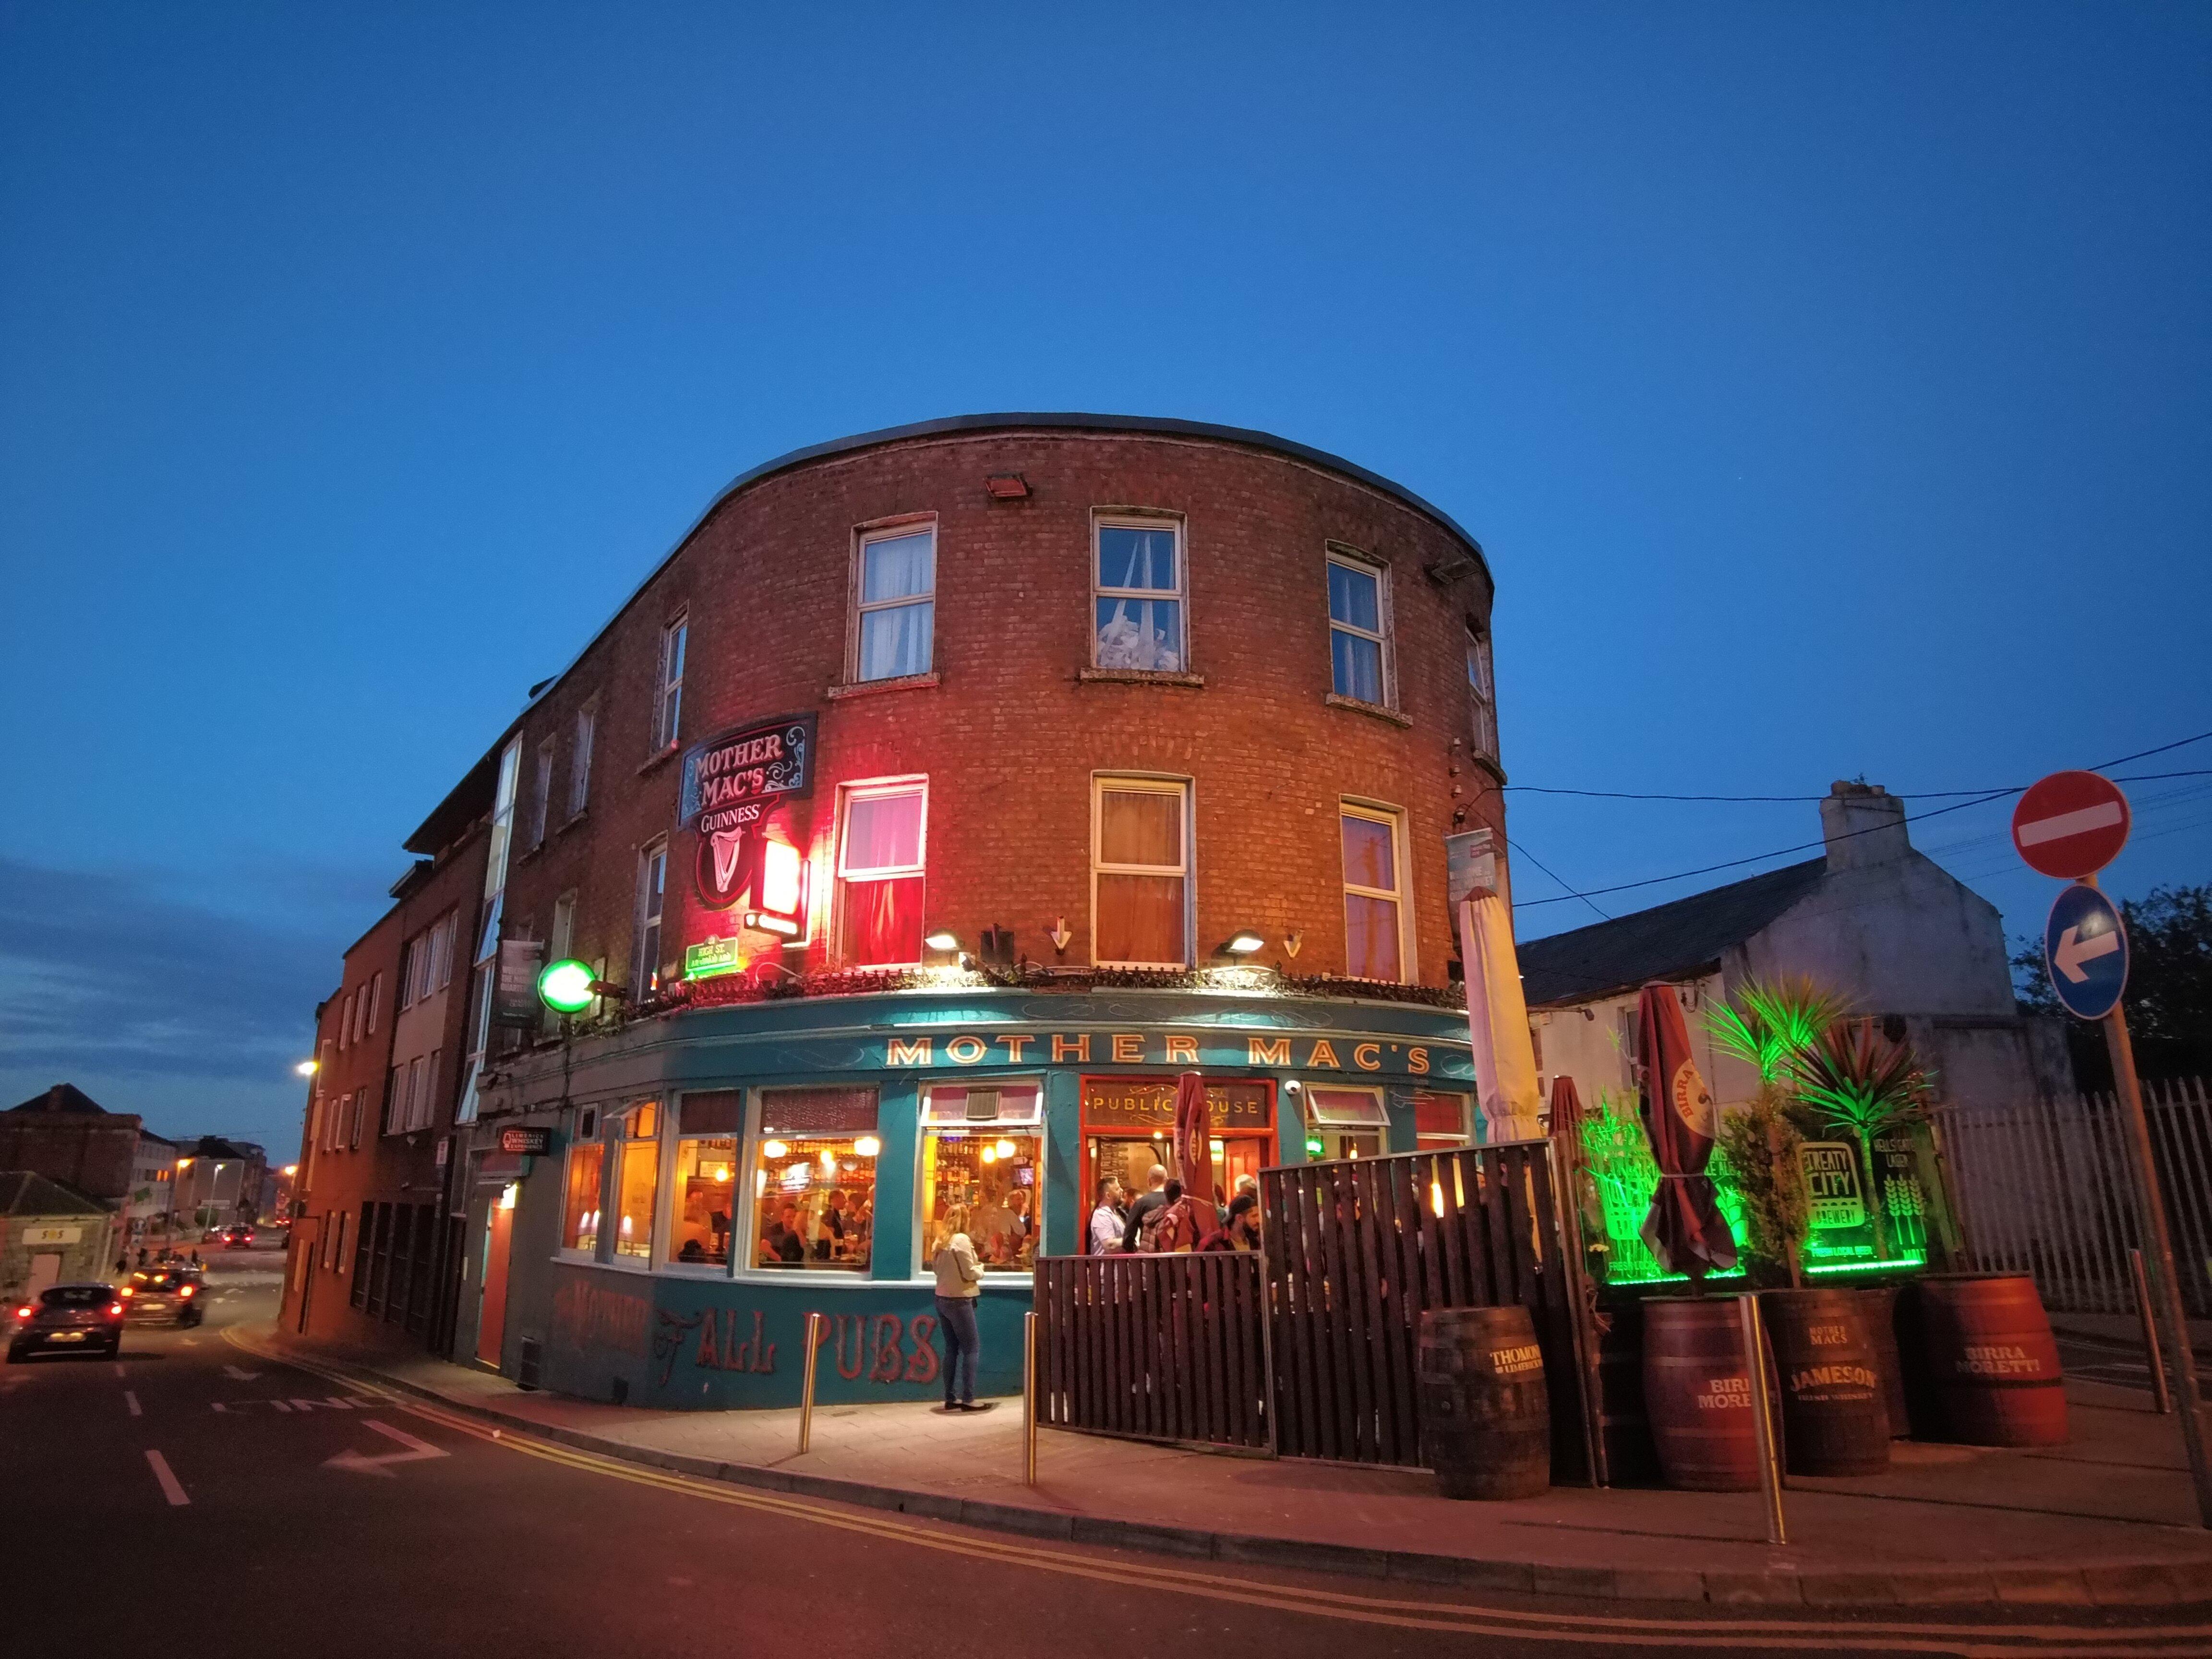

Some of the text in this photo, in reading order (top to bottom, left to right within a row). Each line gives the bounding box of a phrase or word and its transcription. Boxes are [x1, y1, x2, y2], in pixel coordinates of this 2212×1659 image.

[694, 734, 784, 783] MOTHER
[701, 768, 764, 807] MAC'S
[701, 804, 760, 832] GUINNESS
[886, 1034, 1430, 1074] MOTHER MAC'S
[1093, 1097, 1258, 1114] PUBLIC OUSE
[1677, 1070, 1694, 1118] BIRRA
[1804, 1151, 1847, 1171] TREATY
[1809, 1171, 1850, 1195] CITY
[1811, 1334, 1848, 1345] MACS
[1790, 1366, 1877, 1392] JAMESON
[1697, 1394, 1751, 1408] MORE
